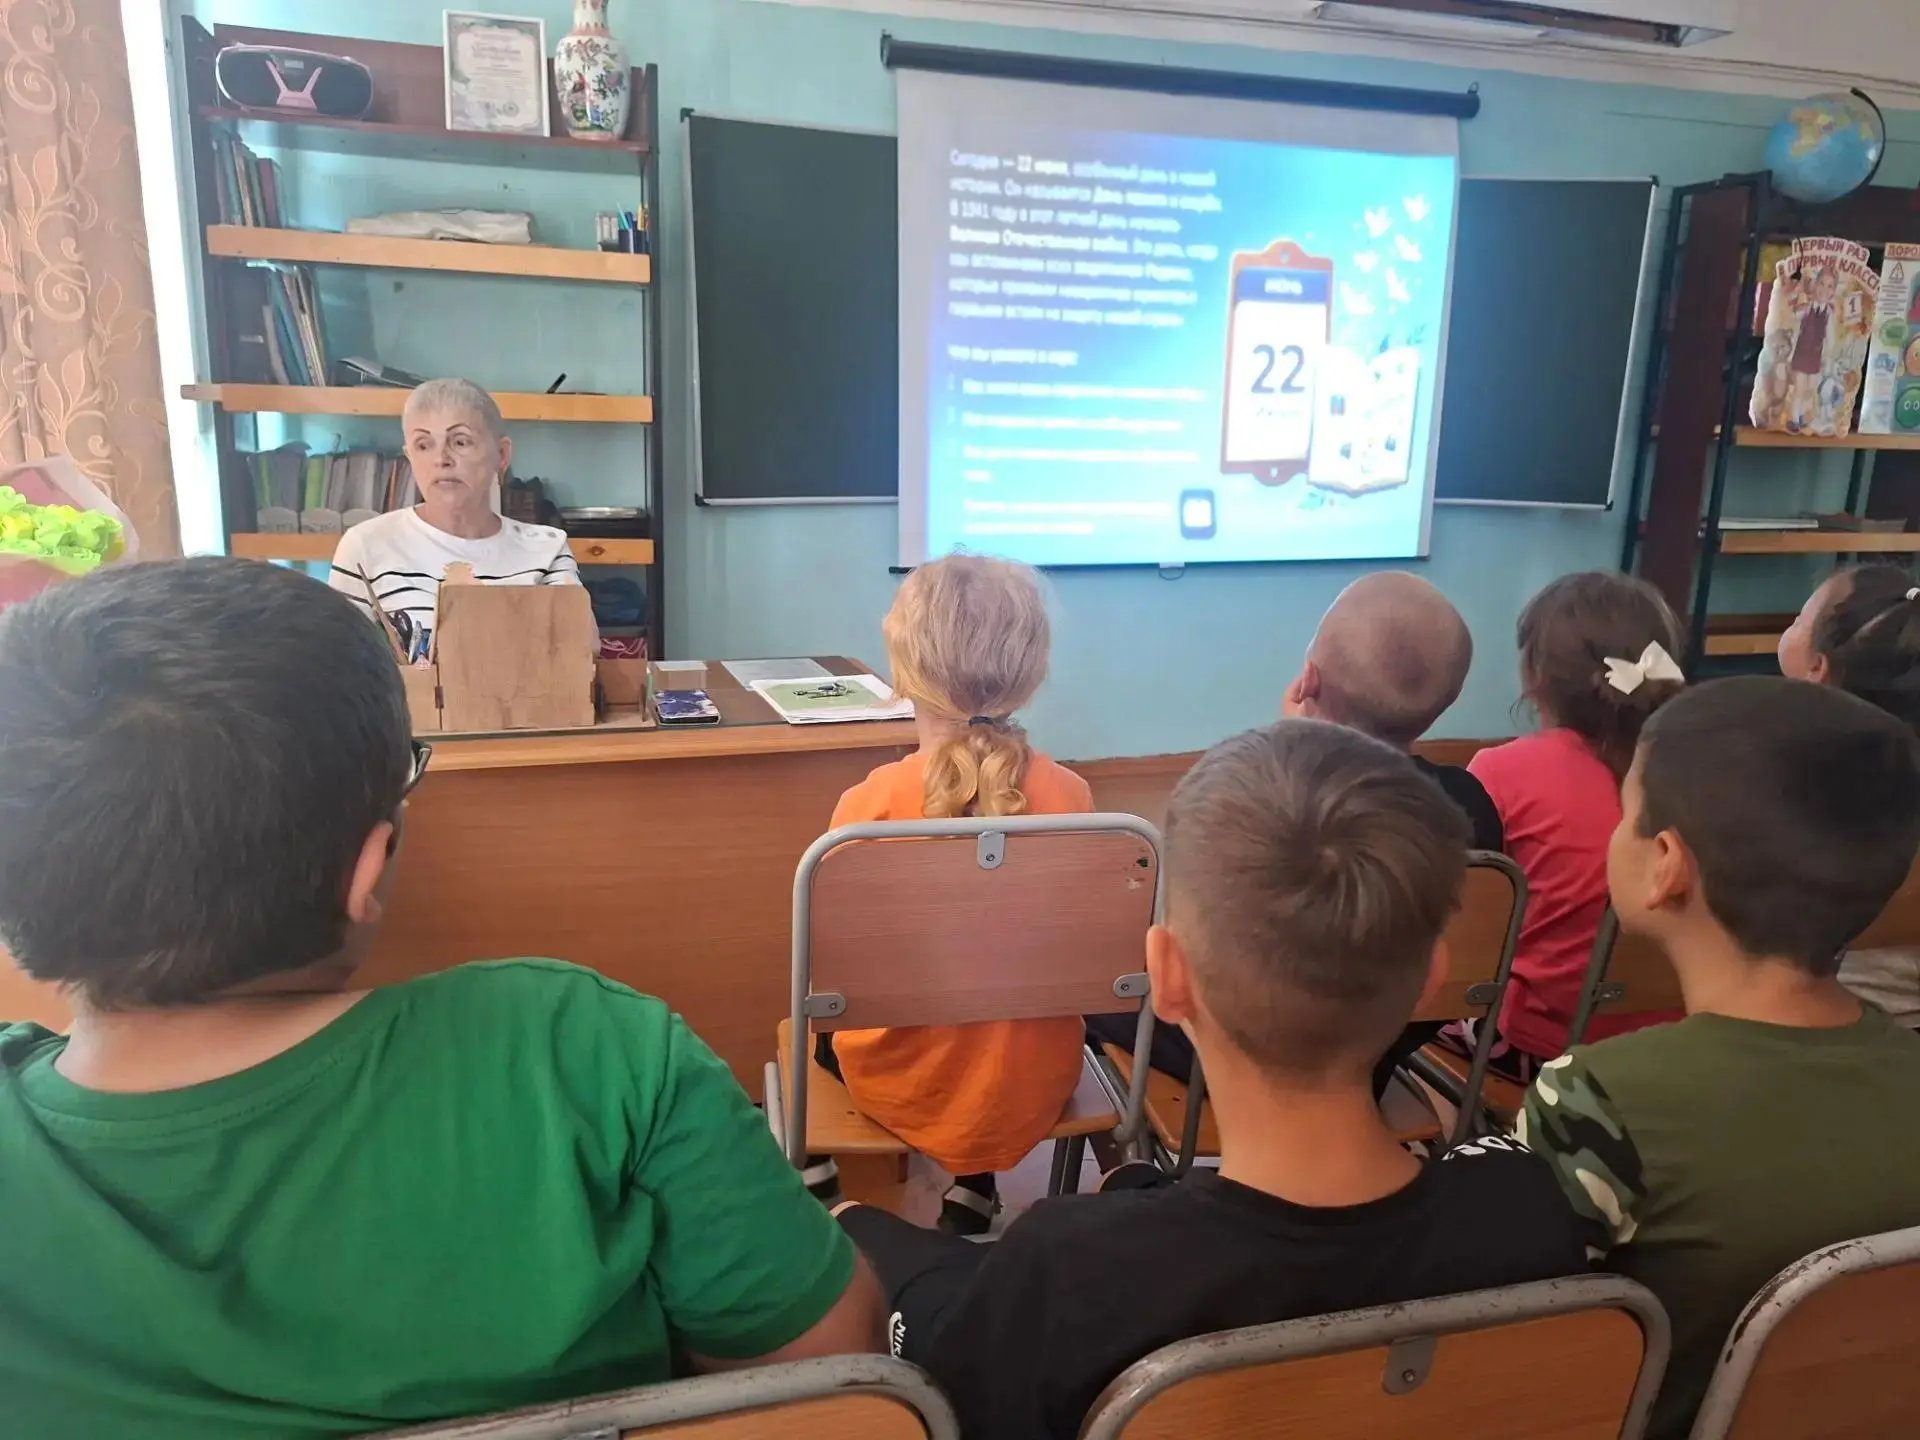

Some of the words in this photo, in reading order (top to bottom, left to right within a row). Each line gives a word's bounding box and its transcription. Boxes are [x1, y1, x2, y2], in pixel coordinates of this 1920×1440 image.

[962, 200, 989, 219] 1941
[1794, 239, 1845, 253] ПЕРВЫЙ
[1846, 243, 1868, 262] РАЗ
[1849, 297, 1858, 313] 1
[1250, 344, 1306, 394] 22
